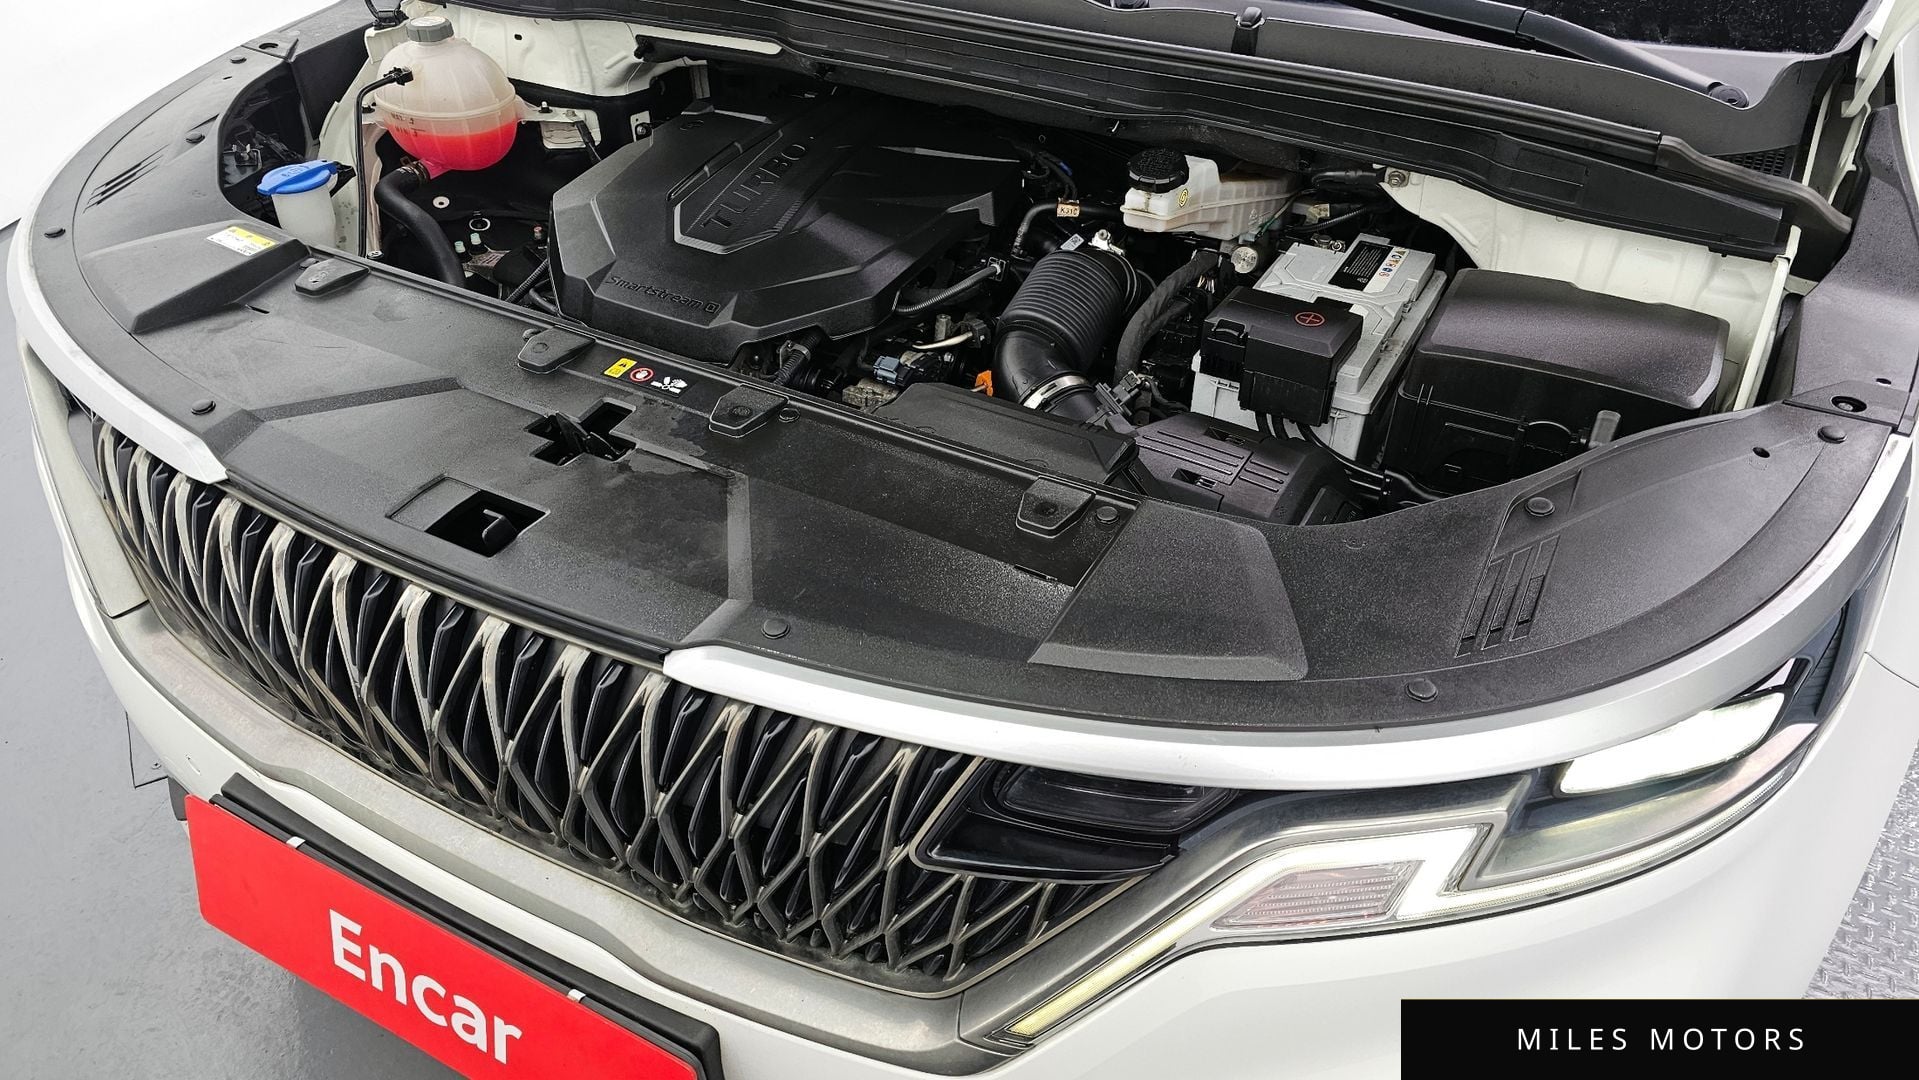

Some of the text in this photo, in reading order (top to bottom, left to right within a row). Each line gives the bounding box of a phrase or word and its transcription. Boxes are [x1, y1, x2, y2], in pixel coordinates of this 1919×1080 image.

[700, 143, 808, 229] TURBO
[605, 275, 703, 309] Smartstream
[329, 909, 522, 1065] Encar
